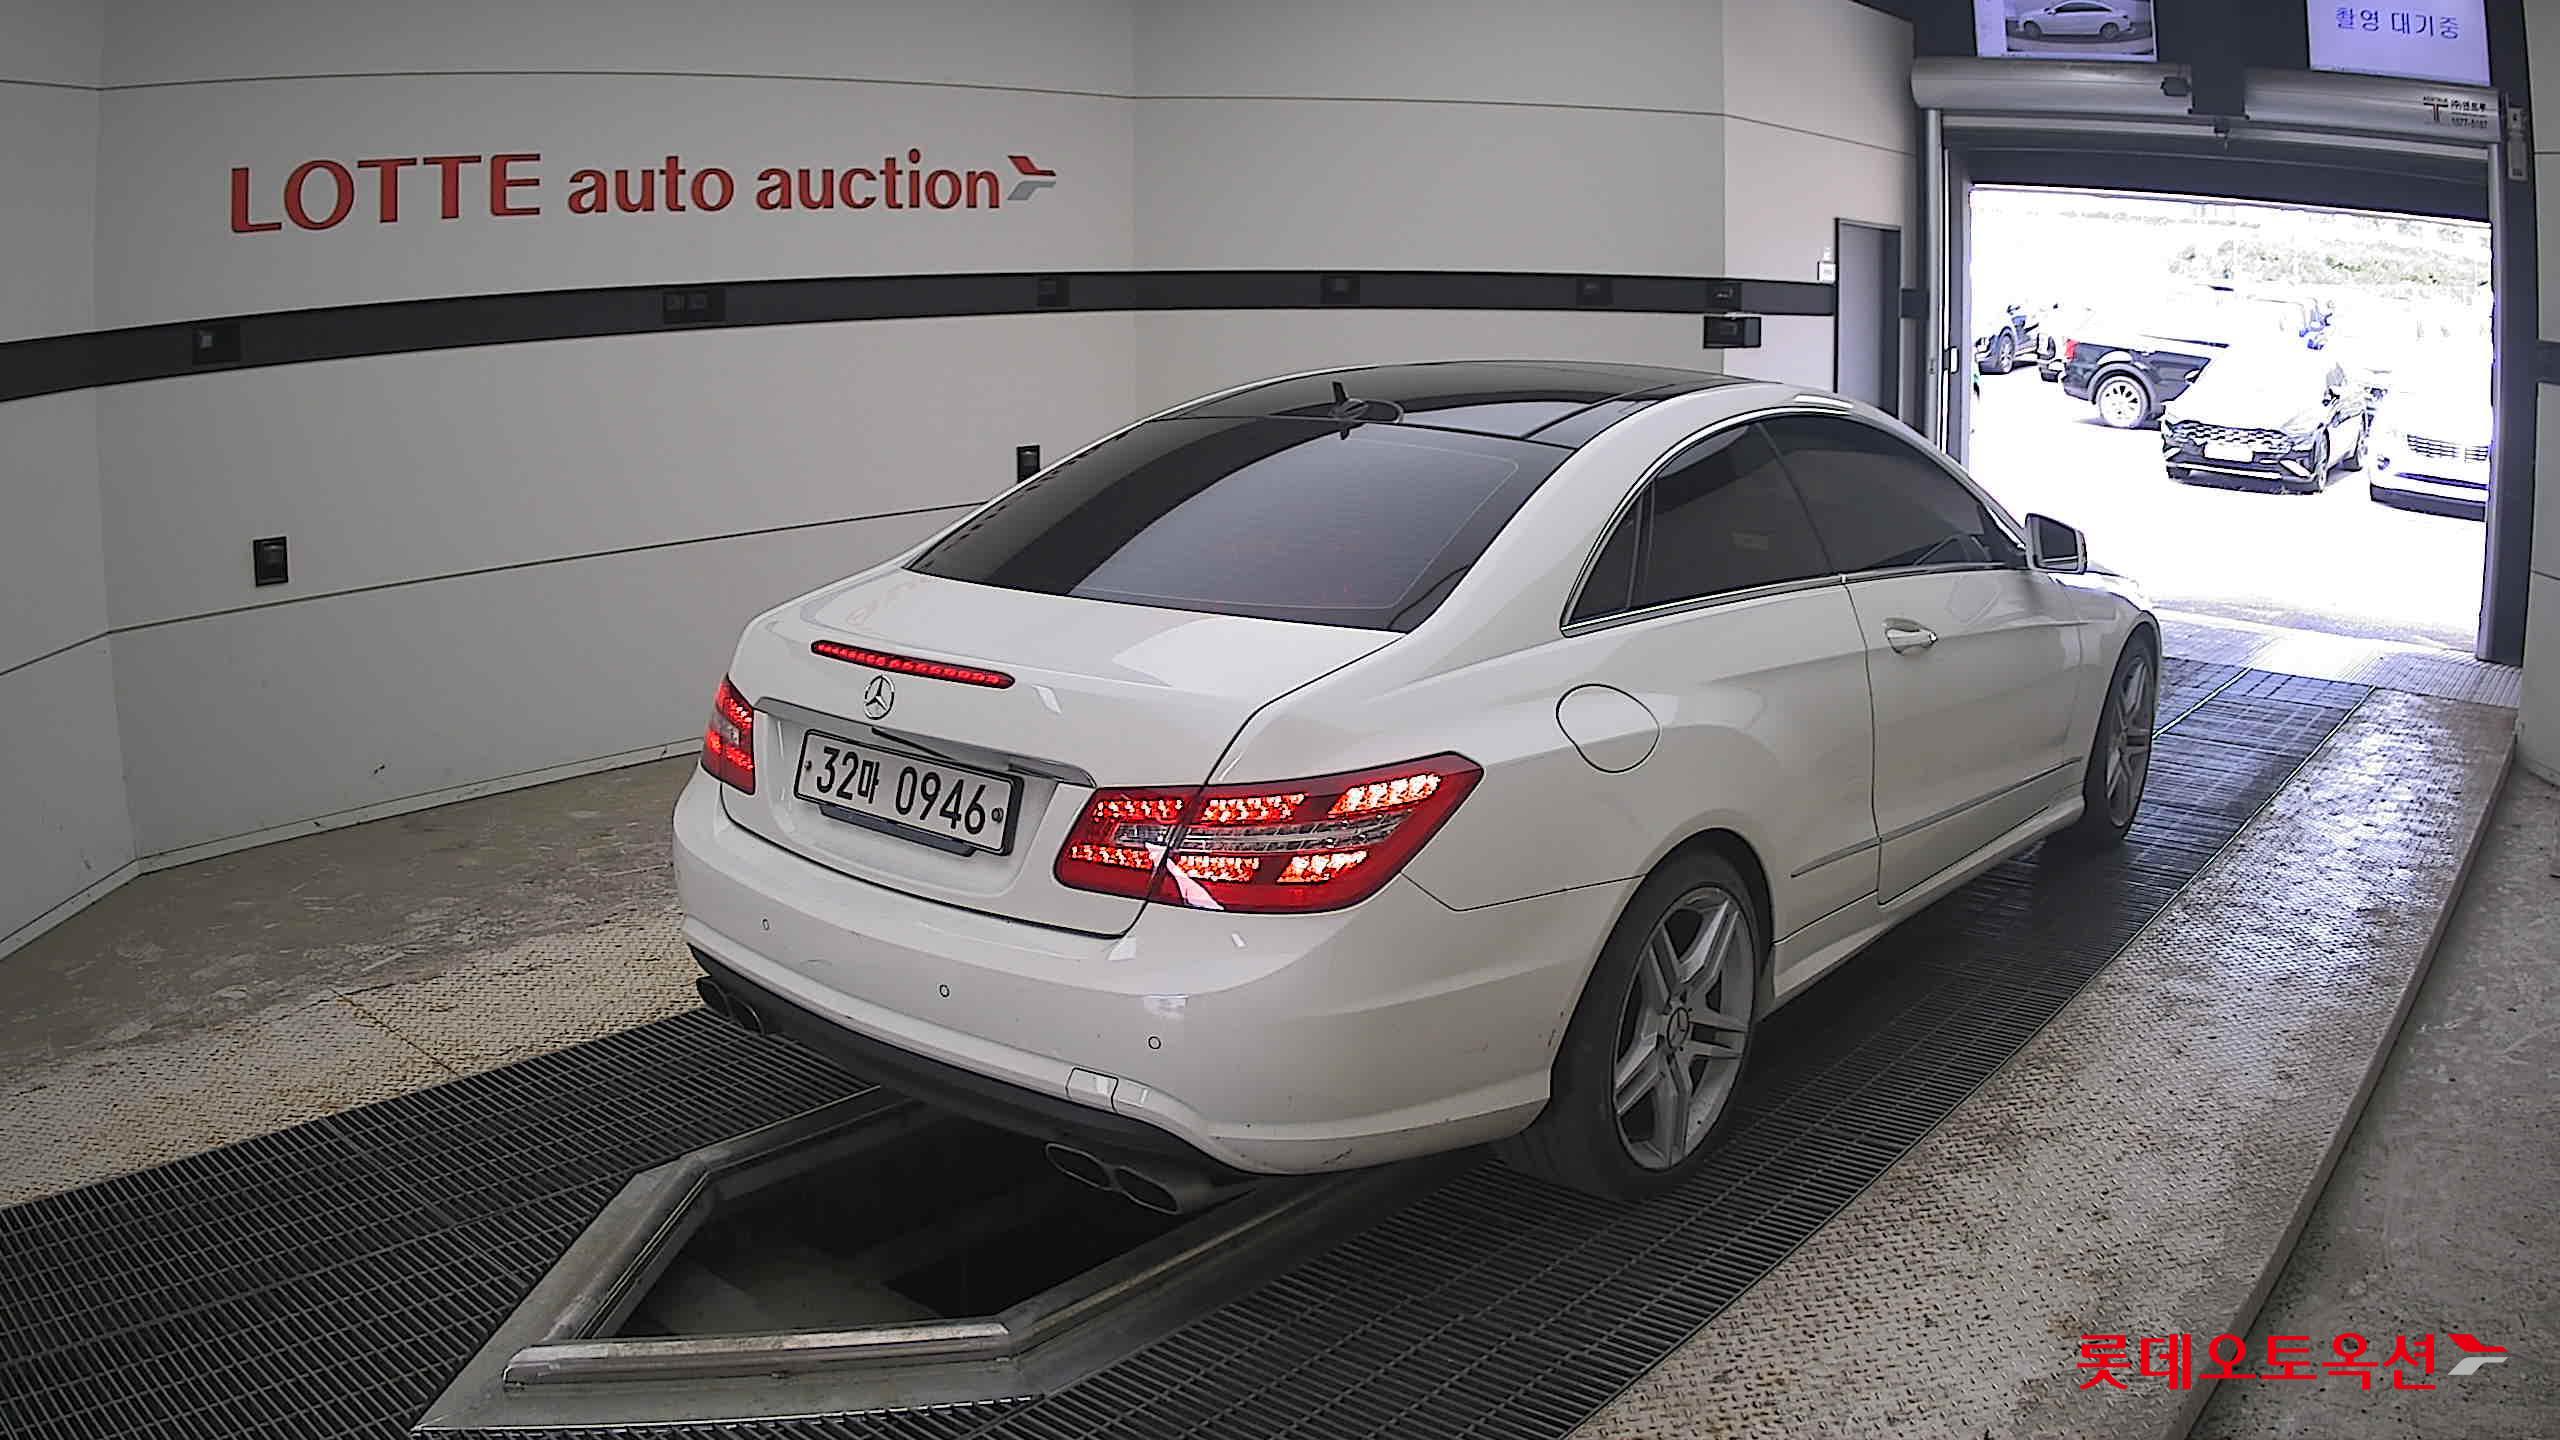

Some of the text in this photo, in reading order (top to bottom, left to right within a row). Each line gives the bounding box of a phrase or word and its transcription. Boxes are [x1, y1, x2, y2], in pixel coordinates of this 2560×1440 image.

[2336, 7, 2459, 39] 촬영 대기중
[231, 148, 1002, 233] LOTTE auto auction
[816, 746, 987, 835] 32마 0946
